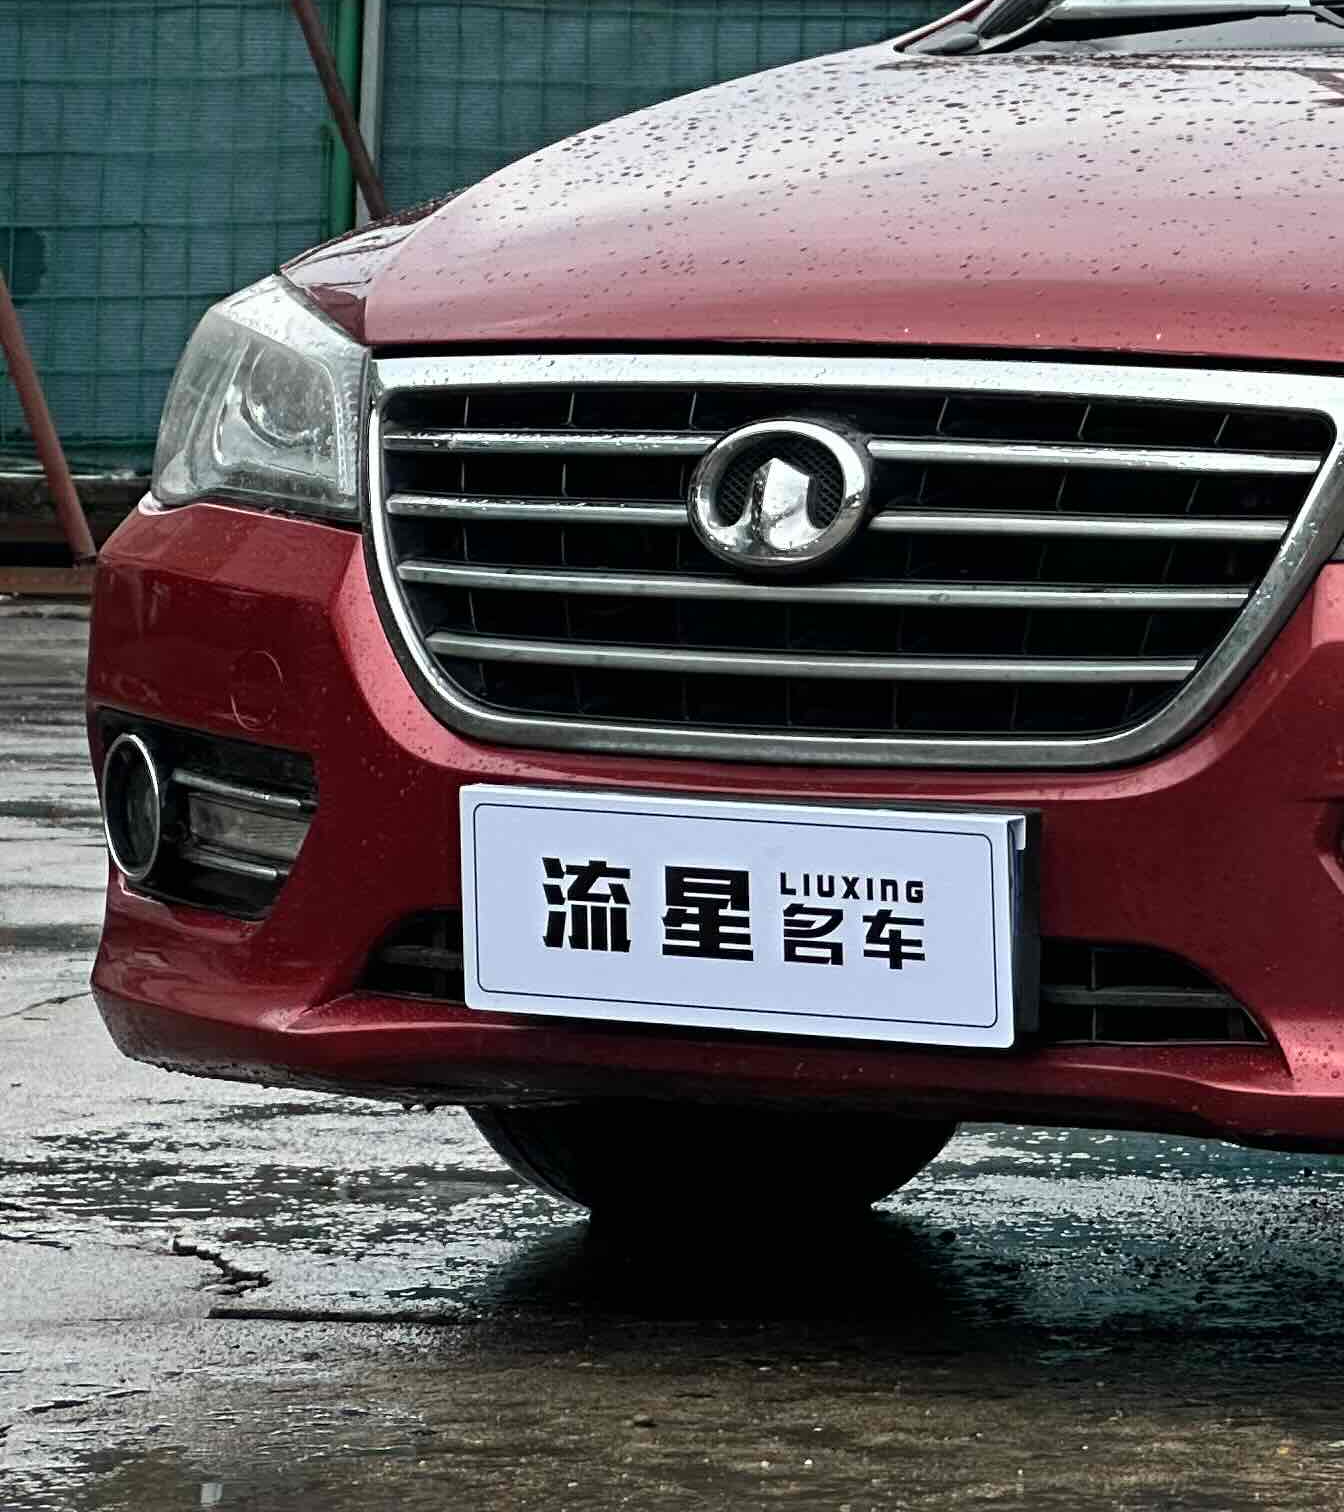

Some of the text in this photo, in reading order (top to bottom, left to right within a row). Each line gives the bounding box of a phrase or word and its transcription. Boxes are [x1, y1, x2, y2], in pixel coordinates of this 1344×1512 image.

[542, 857, 926, 969] 流星名车
[779, 871, 925, 904] LIUXING
